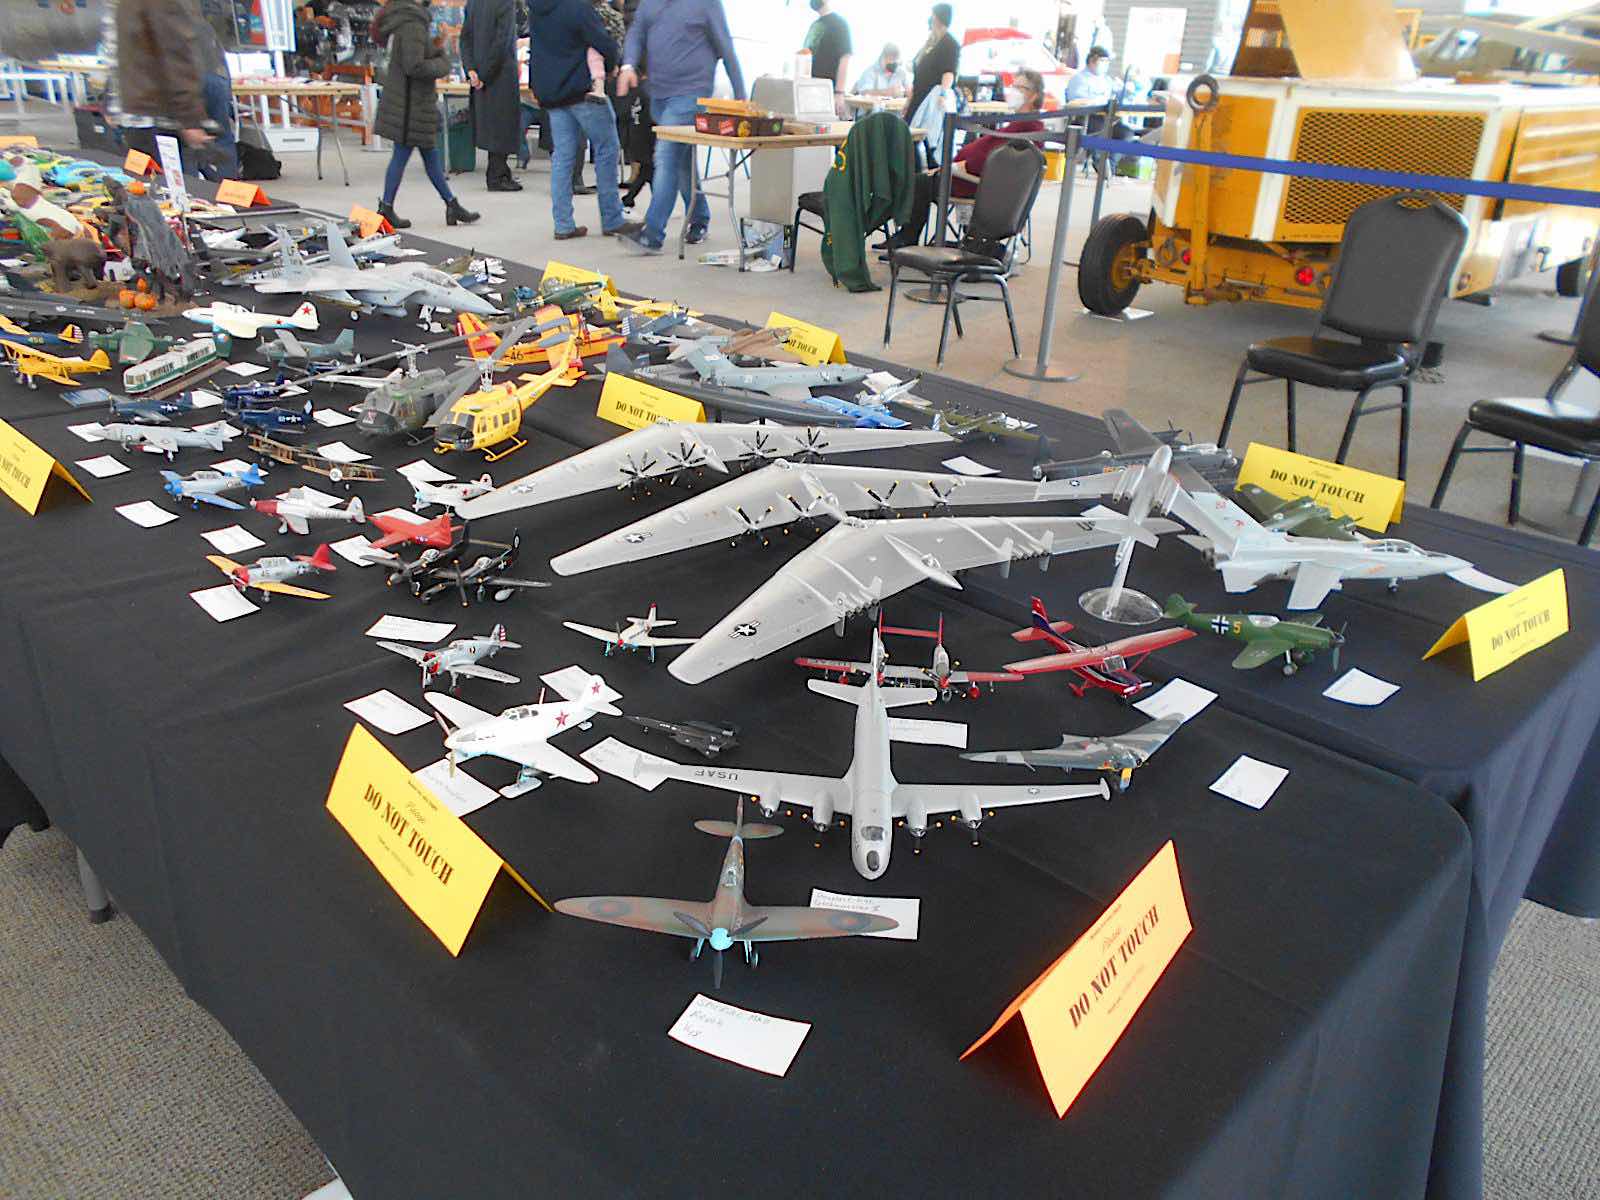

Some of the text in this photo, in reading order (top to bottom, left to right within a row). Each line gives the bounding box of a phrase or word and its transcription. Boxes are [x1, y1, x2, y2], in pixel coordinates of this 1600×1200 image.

[615, 400, 627, 412] DO
[629, 404, 645, 418] NOT
[1270, 469, 1288, 482] DO
[1290, 474, 1317, 491] NOT
[1320, 482, 1366, 504] TOUCH
[1491, 633, 1504, 651] DO
[1504, 624, 1522, 641] NOT
[1522, 609, 1551, 633] TOUCH
[363, 783, 381, 811] DO
[380, 803, 409, 838] NOT
[408, 822, 456, 886] TOUCH
[1069, 992, 1090, 1029] DO
[1090, 954, 1118, 1001] NOT
[1119, 904, 1159, 963] TOUCH
